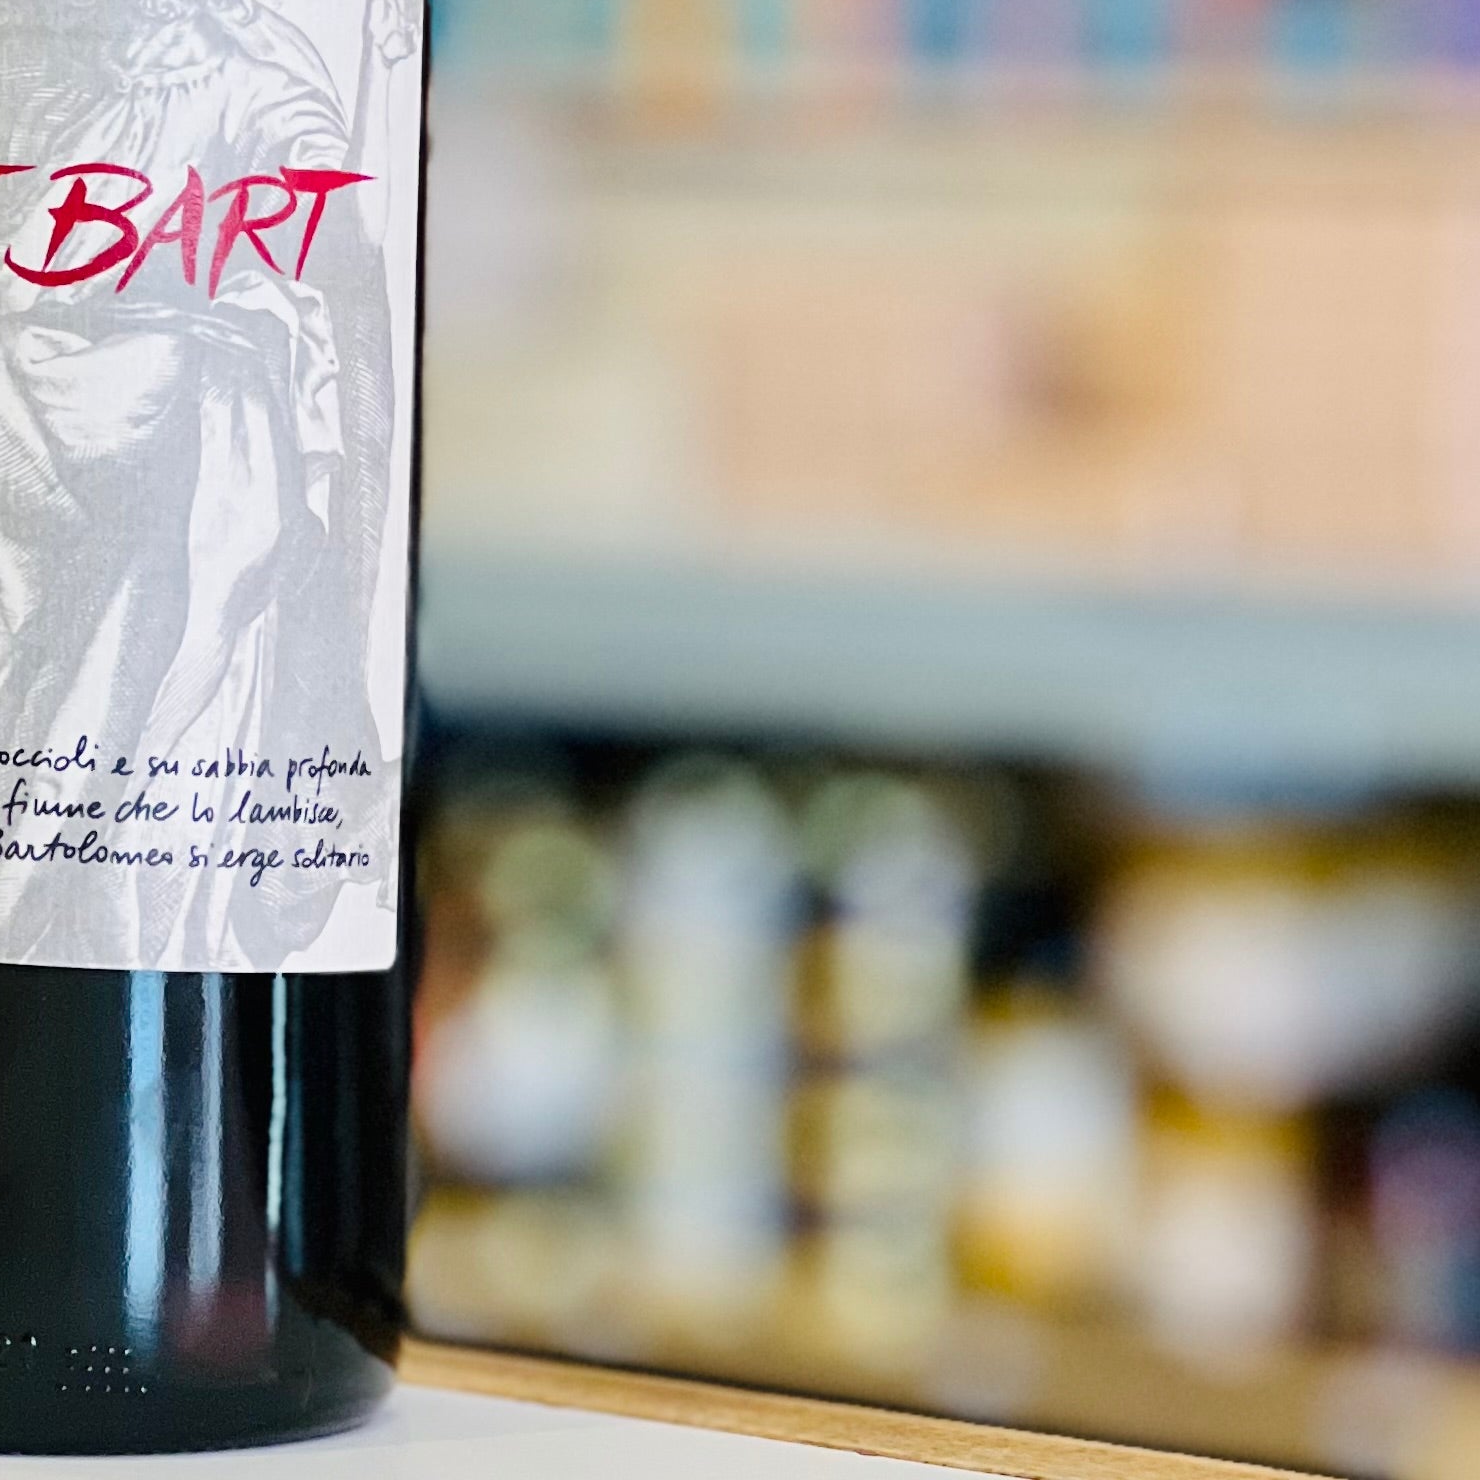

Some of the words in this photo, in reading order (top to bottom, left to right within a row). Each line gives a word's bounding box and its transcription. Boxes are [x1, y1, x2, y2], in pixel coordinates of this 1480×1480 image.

[4, 162, 376, 299] BART
[110, 756, 135, 777] e
[147, 756, 180, 778] su
[191, 747, 275, 779] sabbia
[285, 744, 373, 797] profonda
[1, 777, 106, 827] fiume
[114, 789, 180, 824] che
[191, 791, 215, 824] lo
[227, 789, 344, 830] lambisce,
[188, 843, 214, 869] si
[216, 848, 285, 888] erge
[290, 838, 371, 869] solitario
